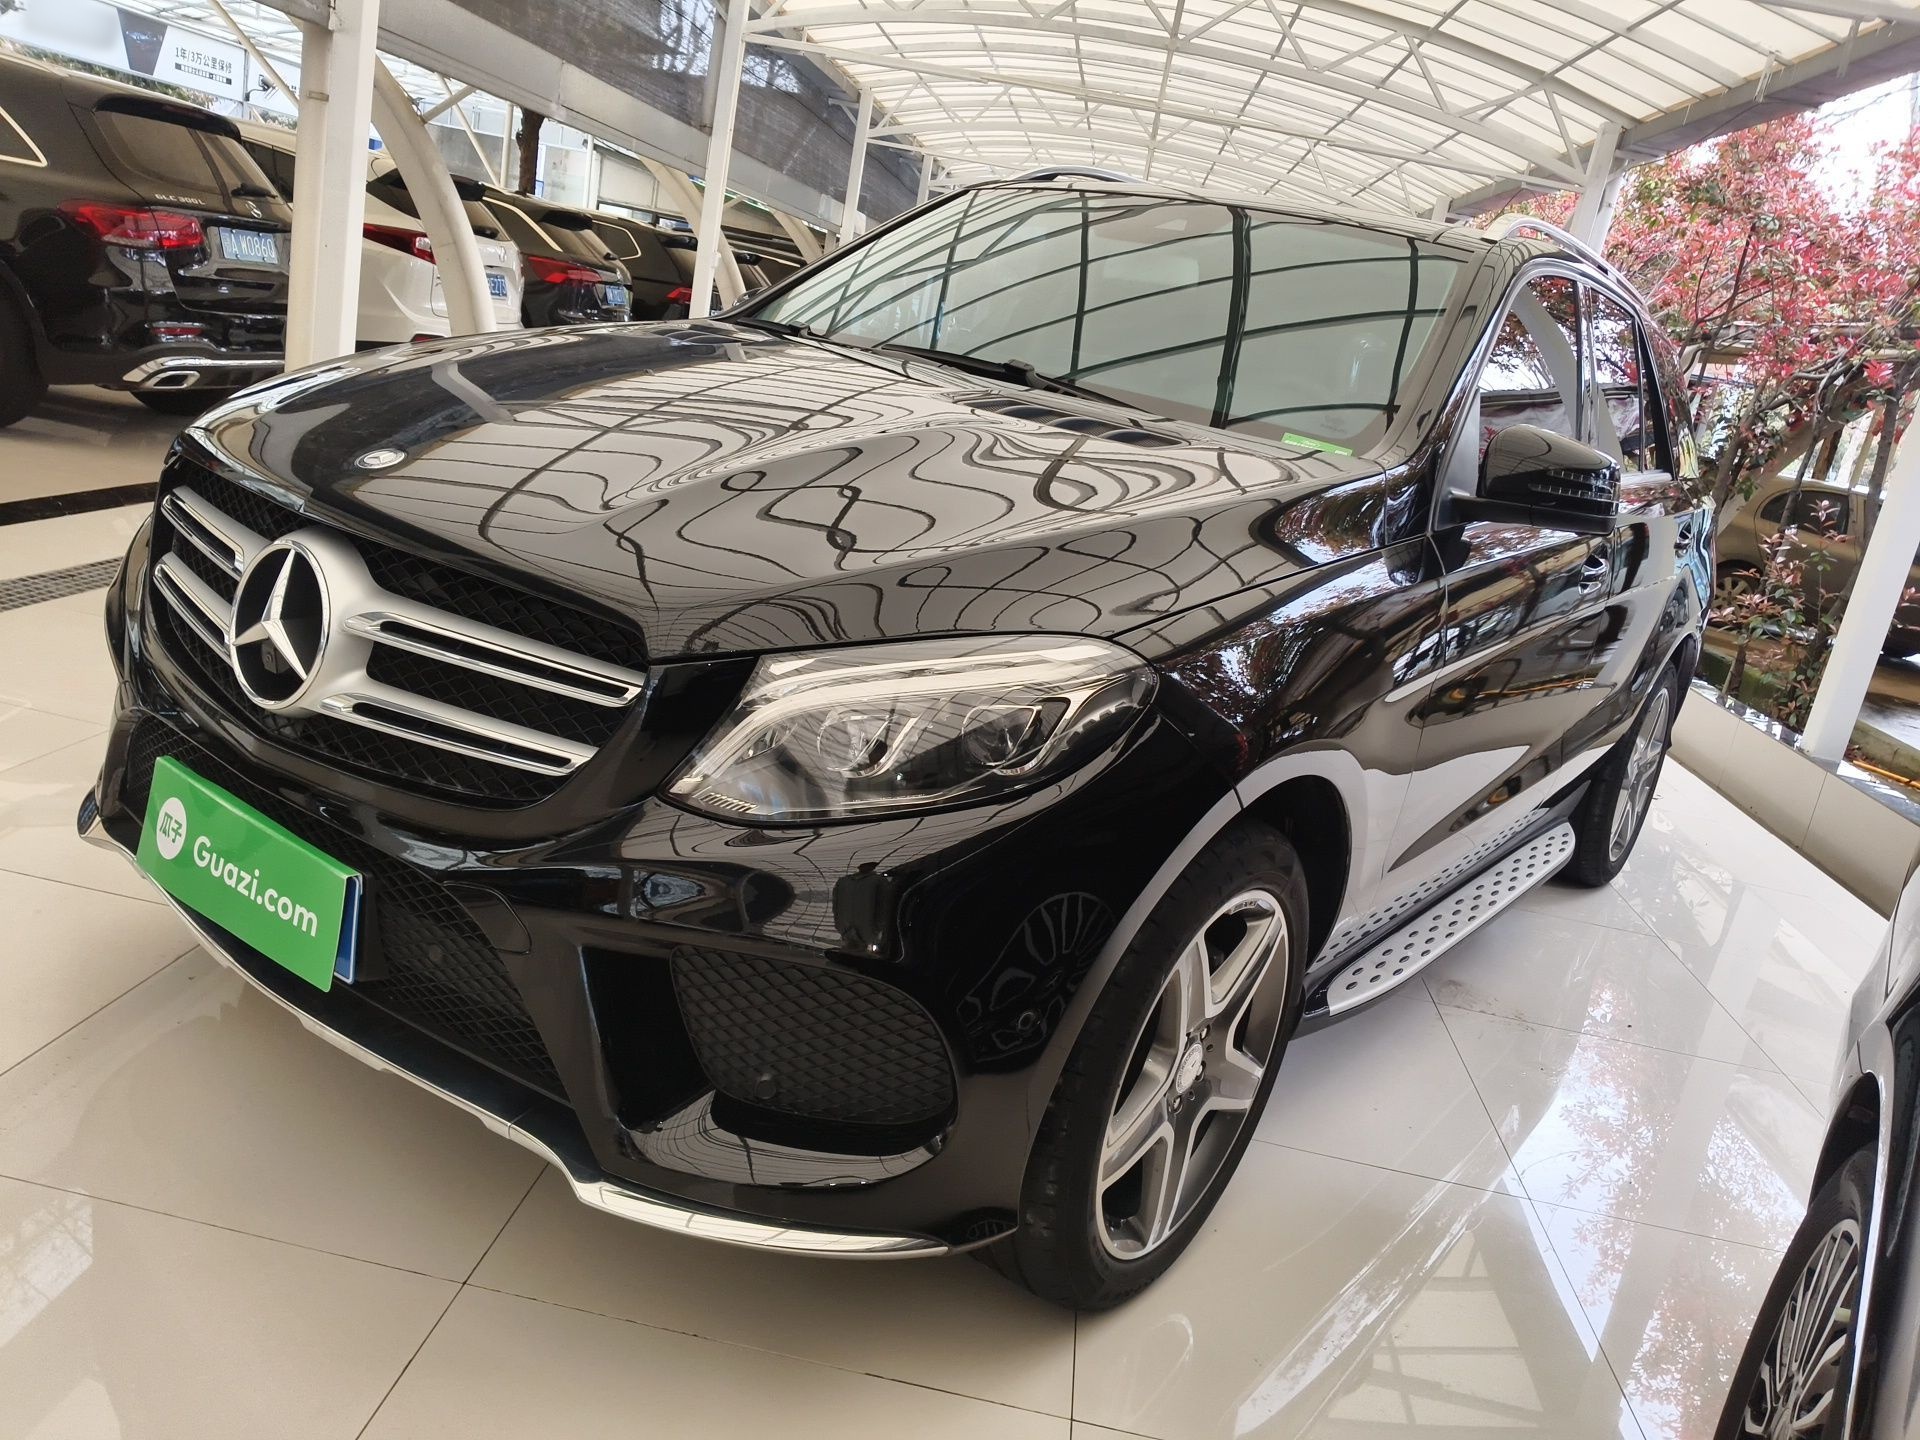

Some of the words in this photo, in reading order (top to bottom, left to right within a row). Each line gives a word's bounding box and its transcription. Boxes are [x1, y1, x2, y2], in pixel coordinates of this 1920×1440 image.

[155, 193, 177, 202] GLC
[159, 811, 183, 844] 瓜子
[193, 835, 318, 937] Guazi.com
